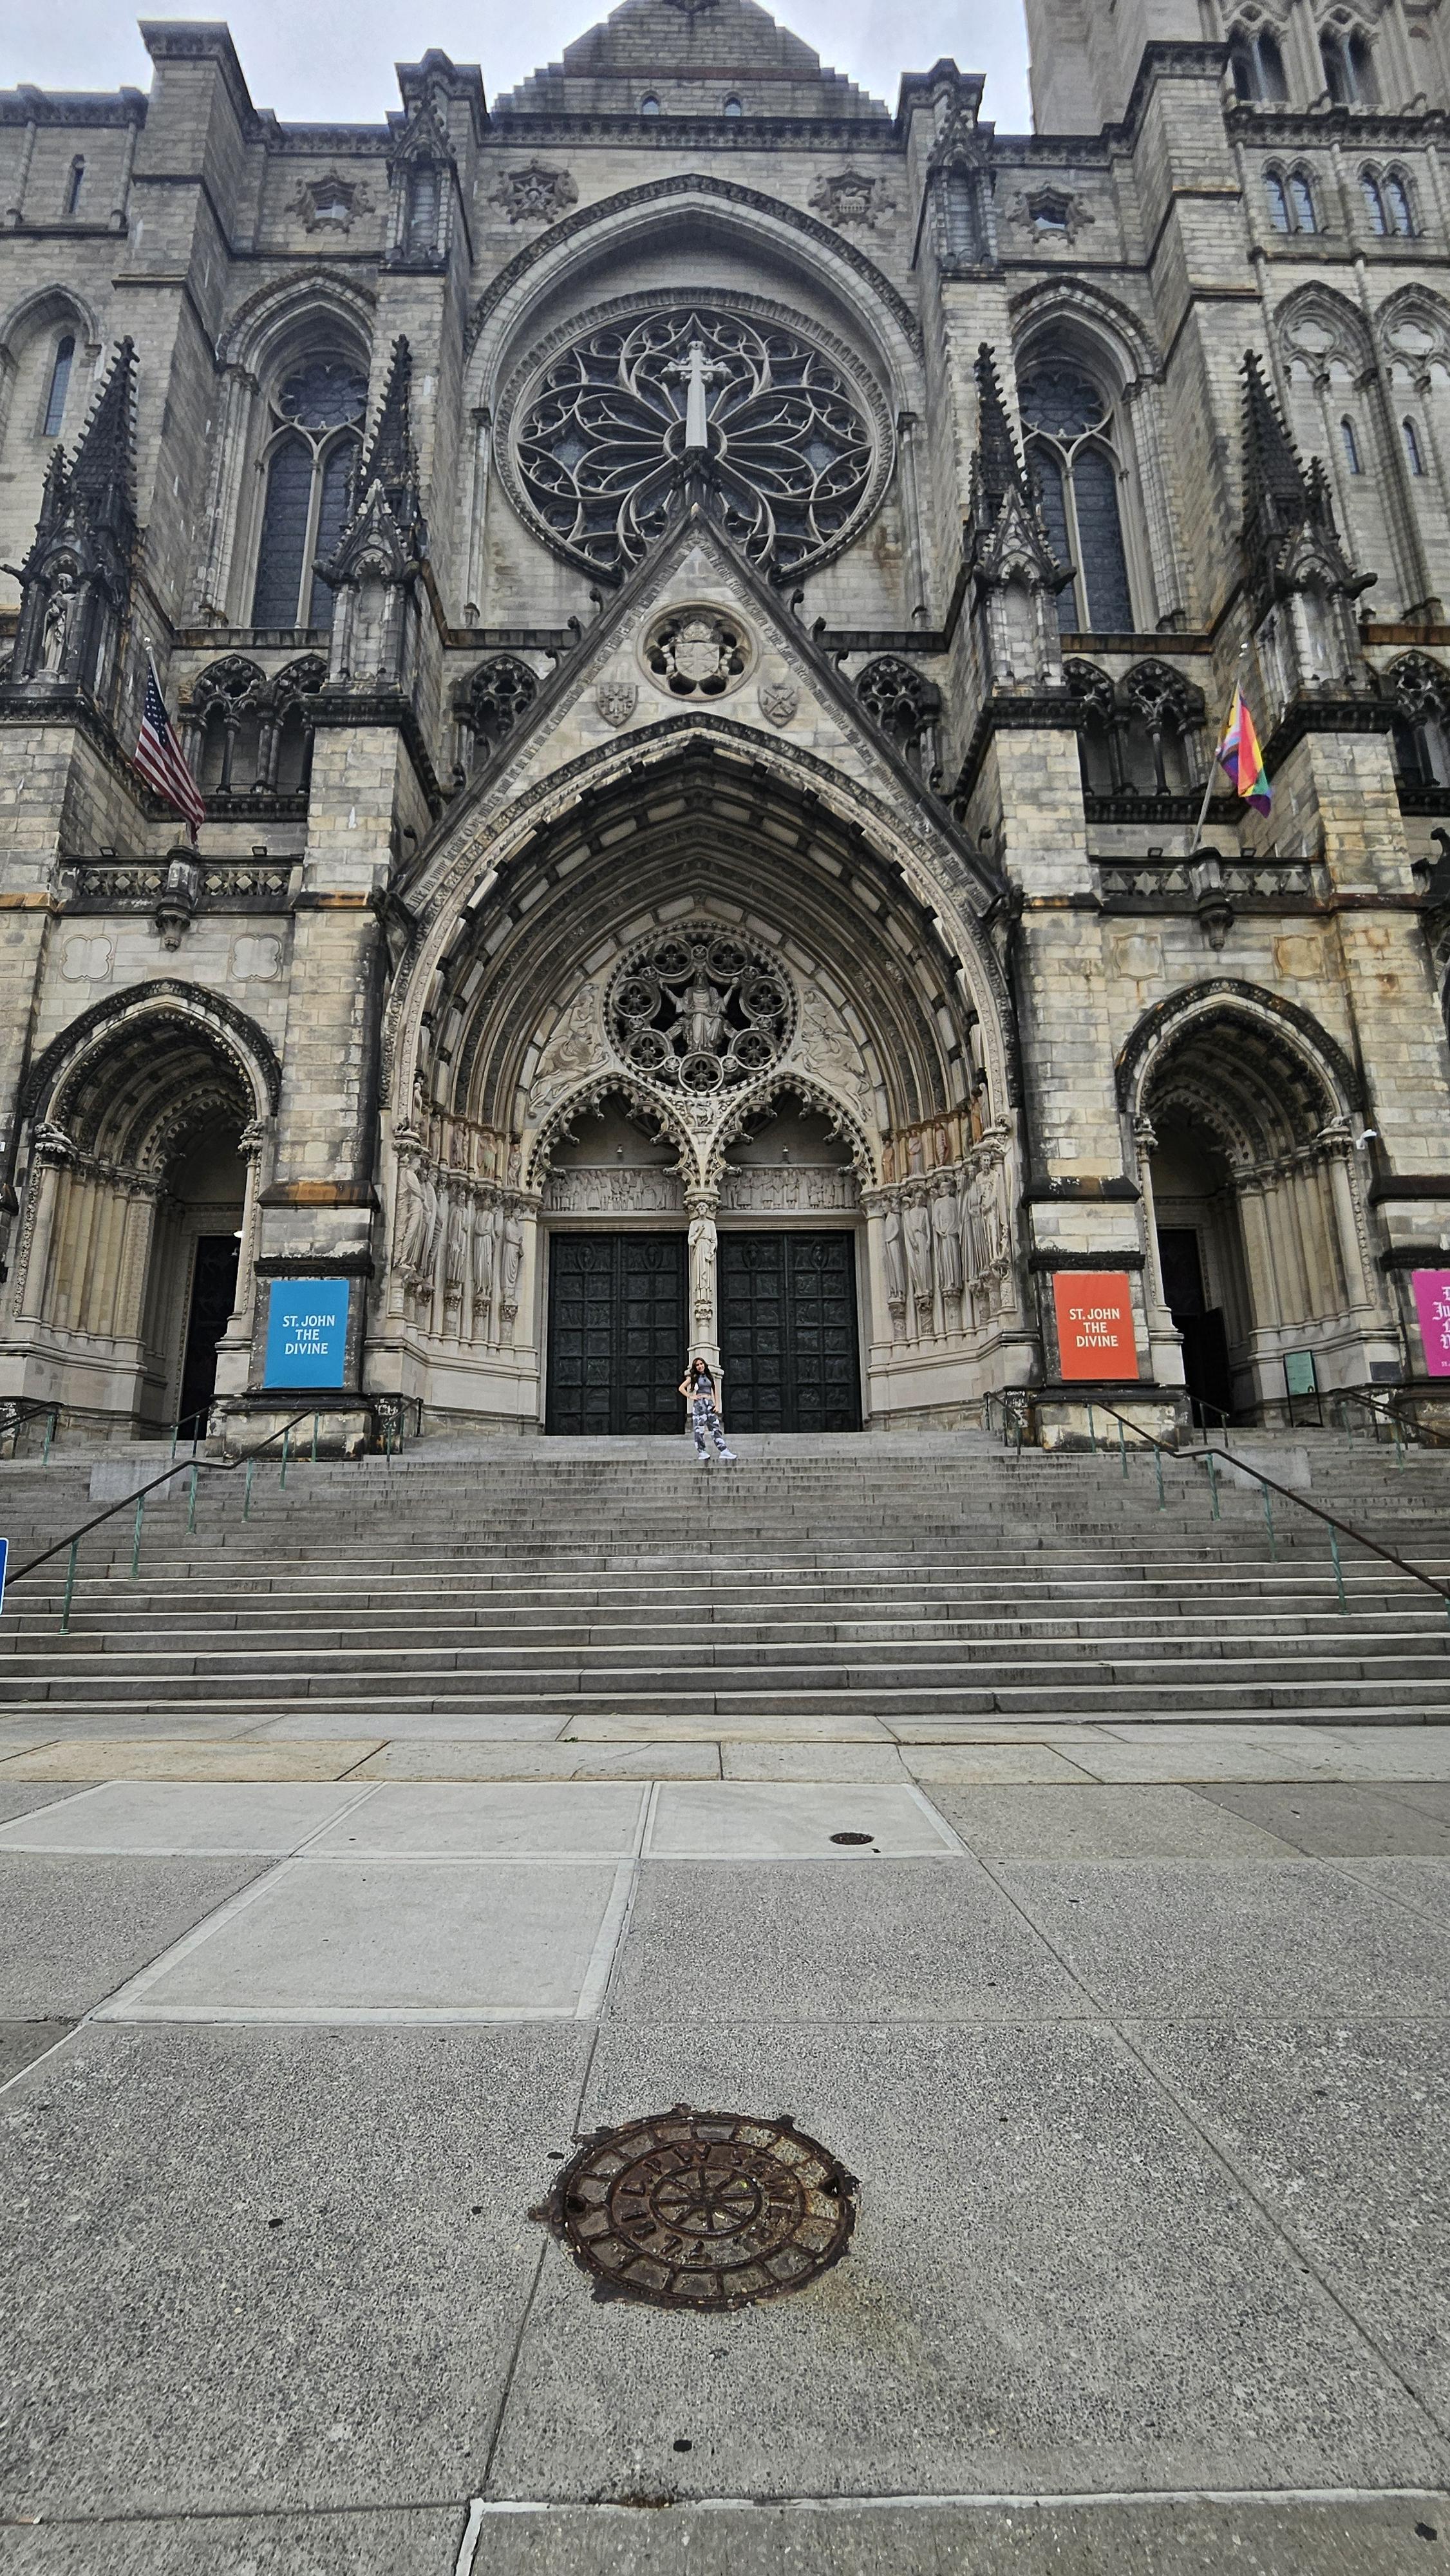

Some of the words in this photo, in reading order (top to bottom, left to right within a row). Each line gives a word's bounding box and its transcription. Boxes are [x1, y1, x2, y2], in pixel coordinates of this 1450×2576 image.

[1069, 1309, 1086, 1320] ST.
[1088, 1308, 1120, 1320] JOHN
[282, 1316, 299, 1327] ST.
[301, 1315, 335, 1327] JOHN
[1084, 1321, 1107, 1333] THE
[296, 1329, 319, 1340] THE
[1076, 1336, 1118, 1347] DIVINE
[285, 1343, 328, 1354] DIVINE
